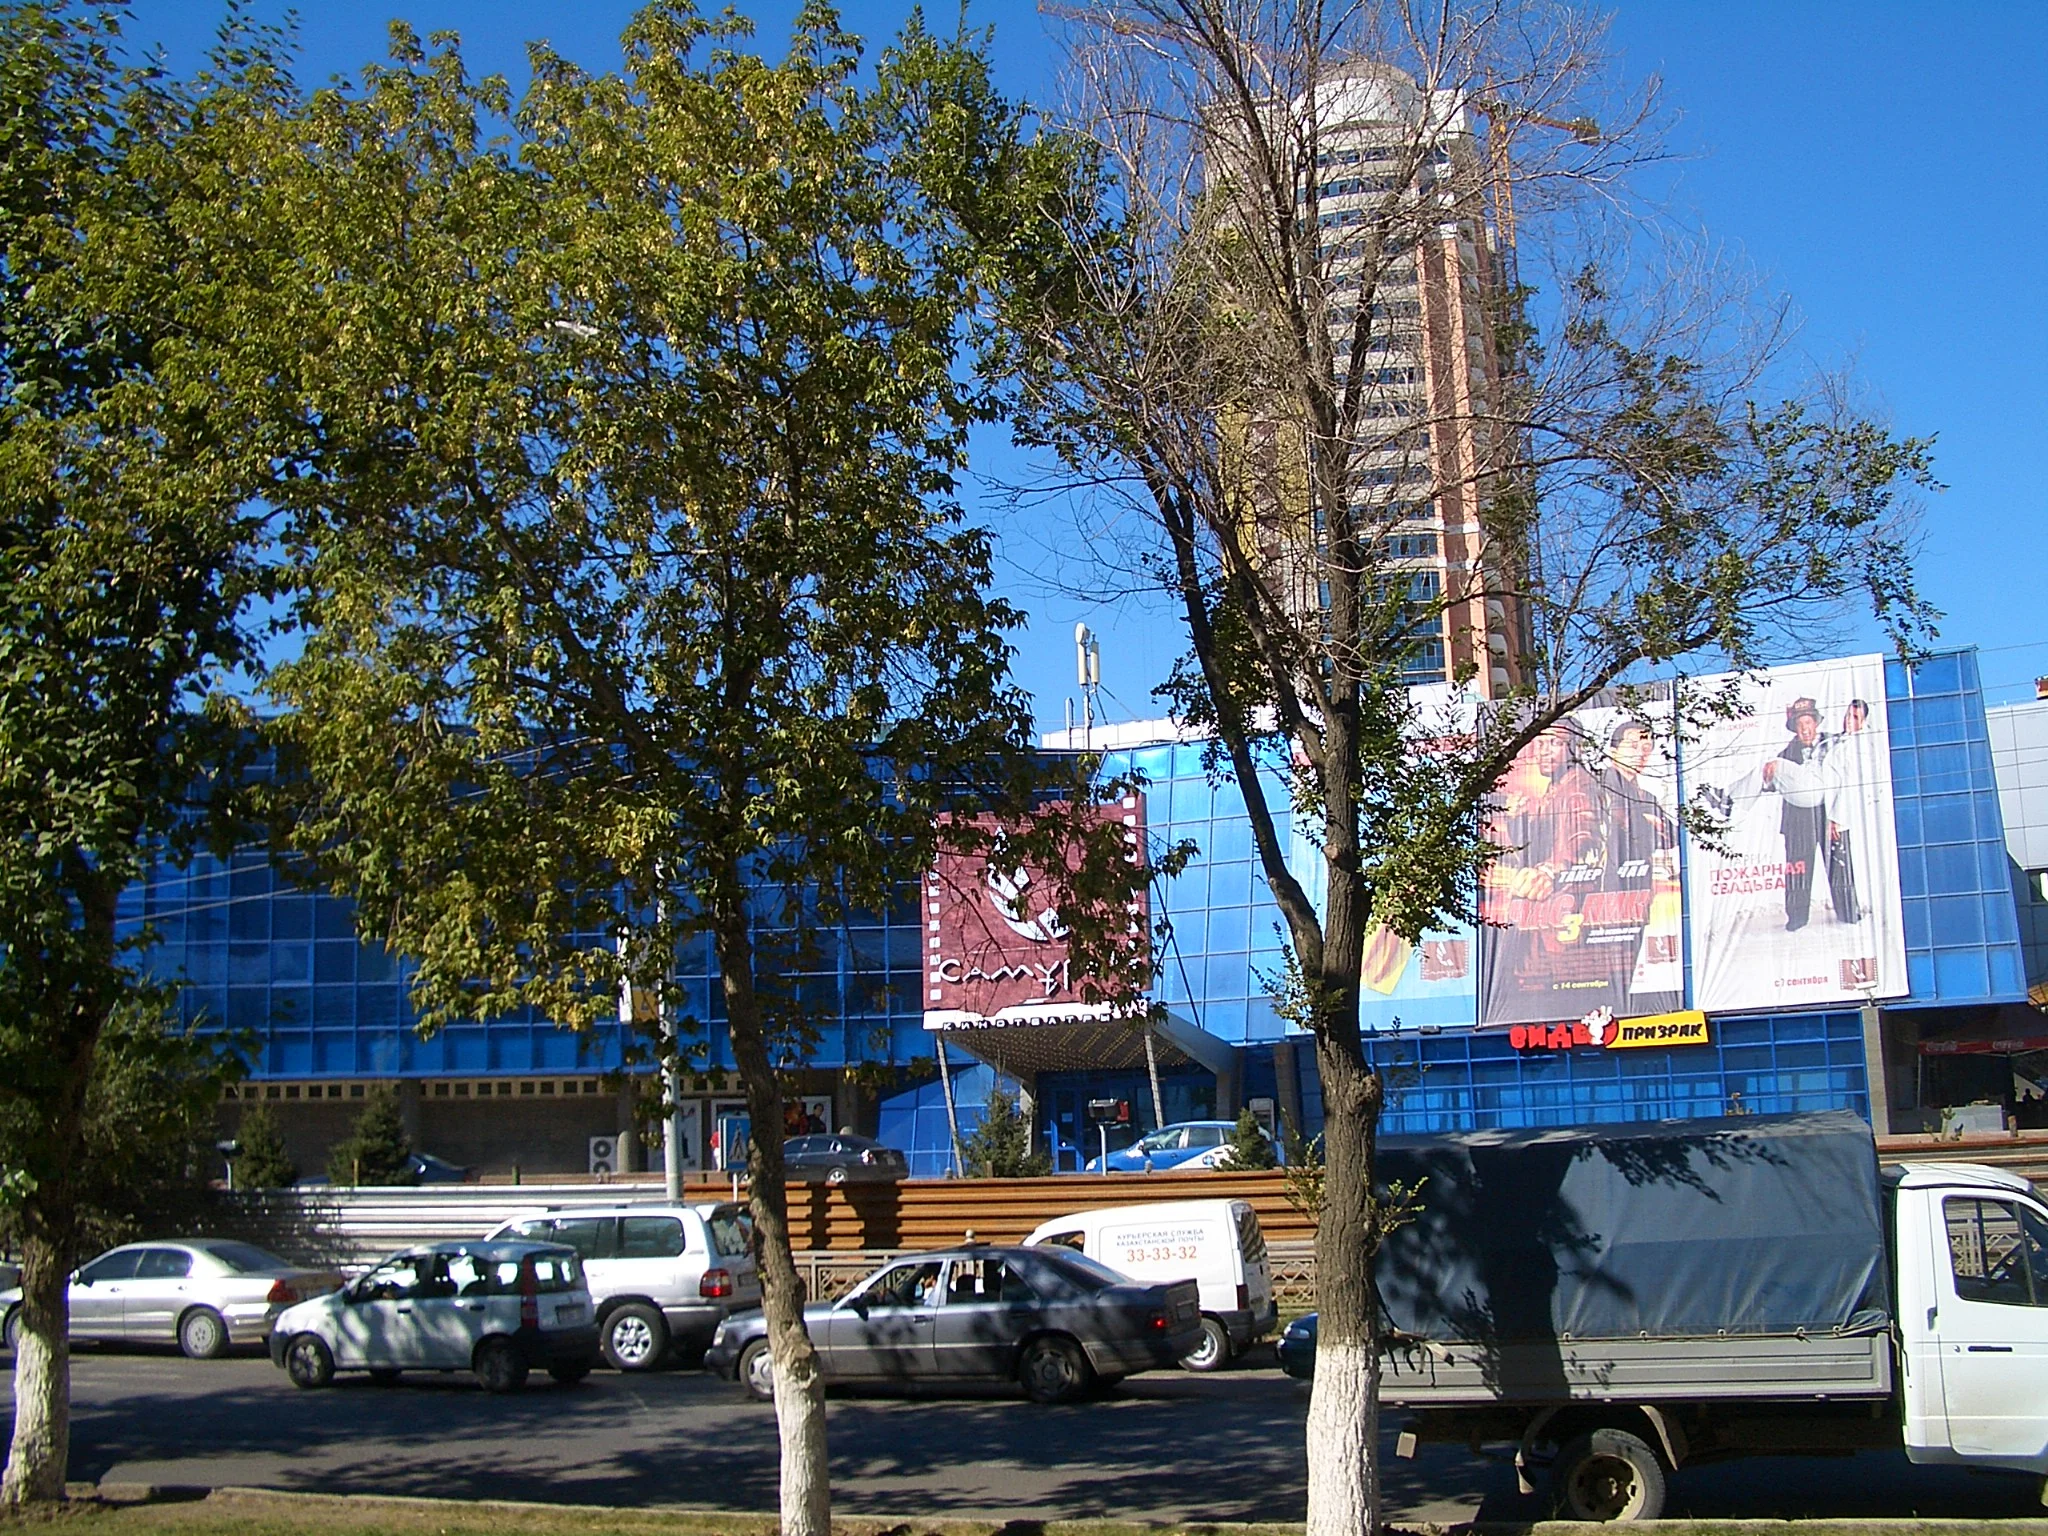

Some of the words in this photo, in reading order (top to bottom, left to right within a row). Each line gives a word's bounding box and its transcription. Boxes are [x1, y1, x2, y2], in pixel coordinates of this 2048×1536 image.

[1559, 868, 1603, 883] ТАКЕР
[1617, 865, 1650, 878] ЧАН
[1709, 860, 1806, 882] ПОЖАРНАЯ
[1710, 877, 1786, 895] СВАДЬБА
[1581, 889, 1652, 926] ПИК
[1556, 913, 1584, 944] 3
[1571, 980, 1609, 990] сентября
[1787, 976, 1829, 987] сентября
[942, 1014, 1111, 1031] КИНОТЕАТРЫ
[1622, 1023, 1703, 1041] ПРИЗРАК
[1117, 1231, 1168, 1240] КУРЬЕРСКАЯ
[1170, 1228, 1204, 1237] СЛУЖБА
[1127, 1245, 1197, 1263] 33-33-32
